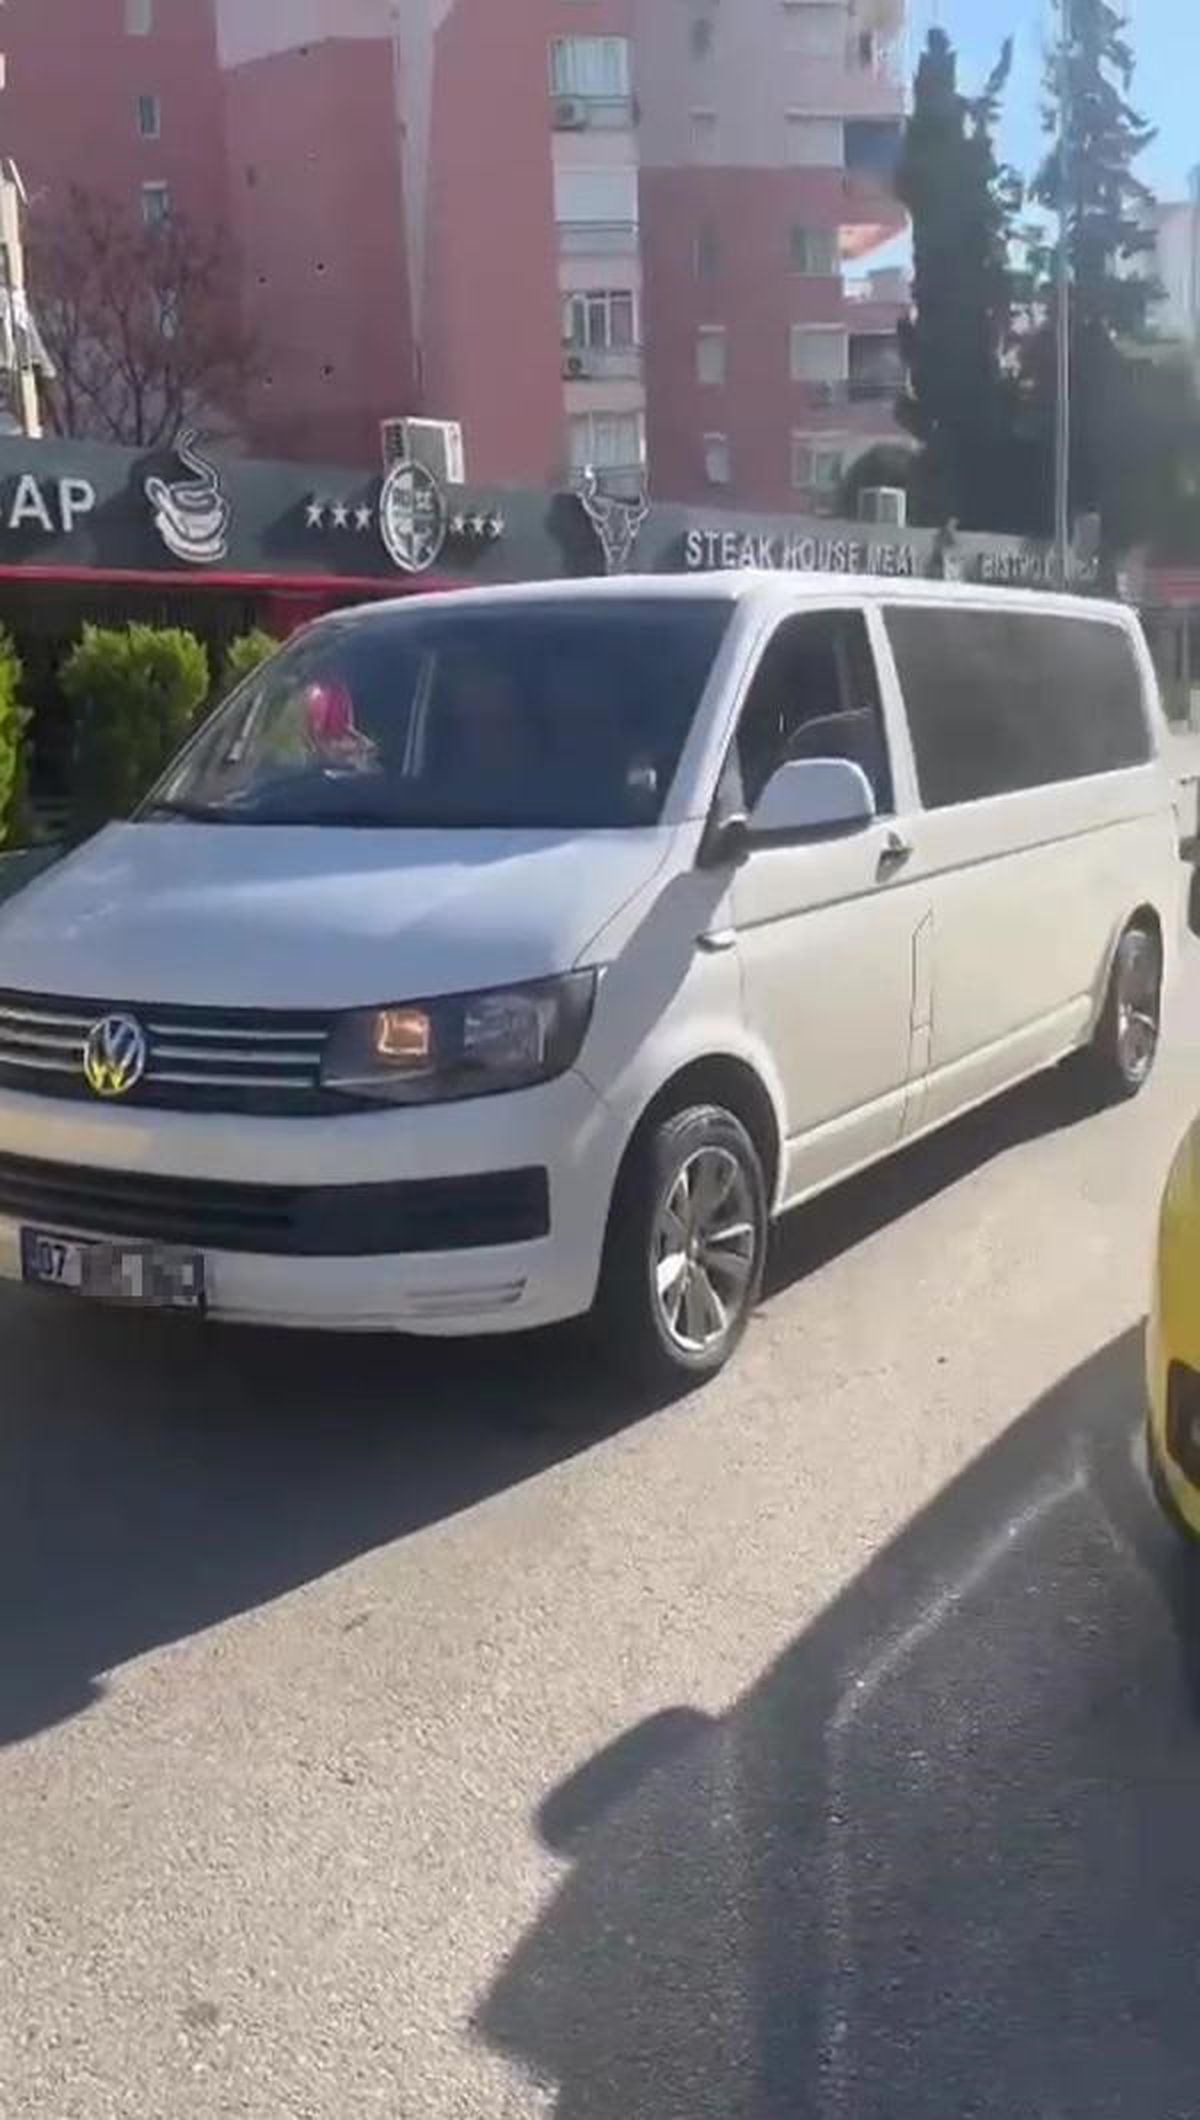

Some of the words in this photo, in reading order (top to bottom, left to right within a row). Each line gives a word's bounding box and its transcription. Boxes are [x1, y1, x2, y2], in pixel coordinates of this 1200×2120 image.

[0, 474, 96, 533] AP
[685, 530, 775, 571] STEAK
[783, 535, 860, 575] HOUSE
